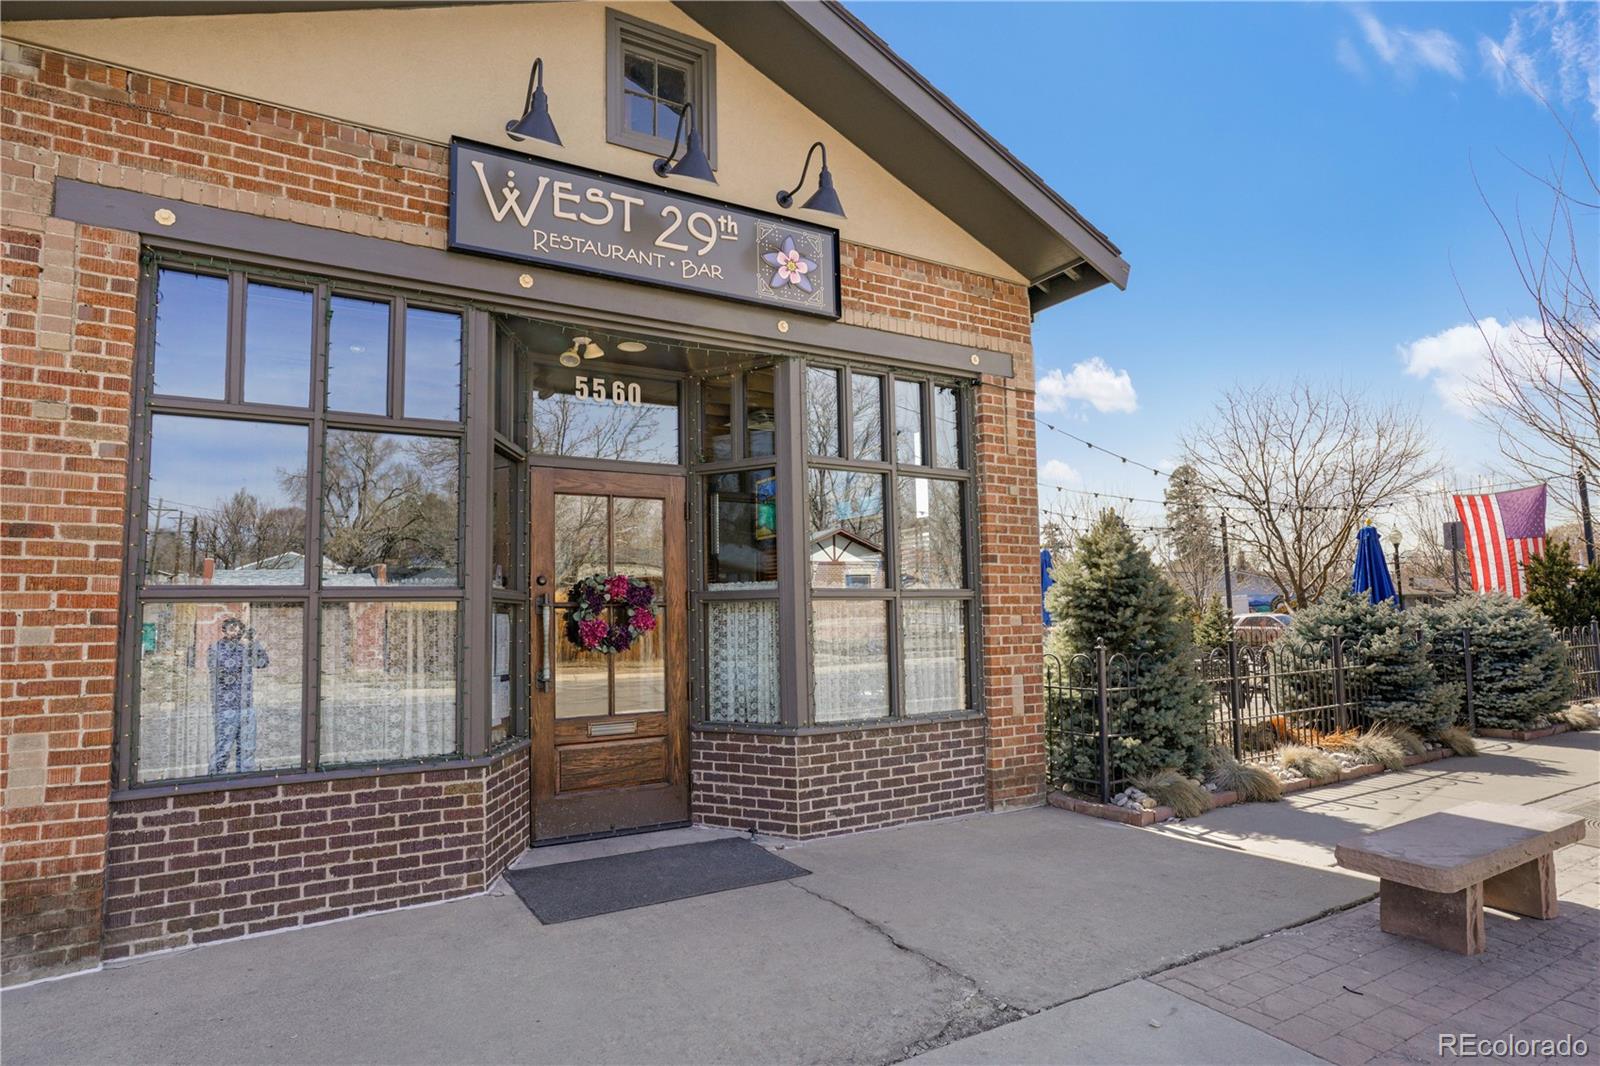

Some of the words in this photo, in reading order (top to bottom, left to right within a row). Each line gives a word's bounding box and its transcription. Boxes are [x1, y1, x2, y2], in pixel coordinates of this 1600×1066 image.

[471, 160, 645, 232] WEST
[654, 205, 738, 256] 29th
[533, 229, 666, 268] RESTAURANT
[681, 259, 724, 280] BAR
[575, 375, 641, 407] 5560
